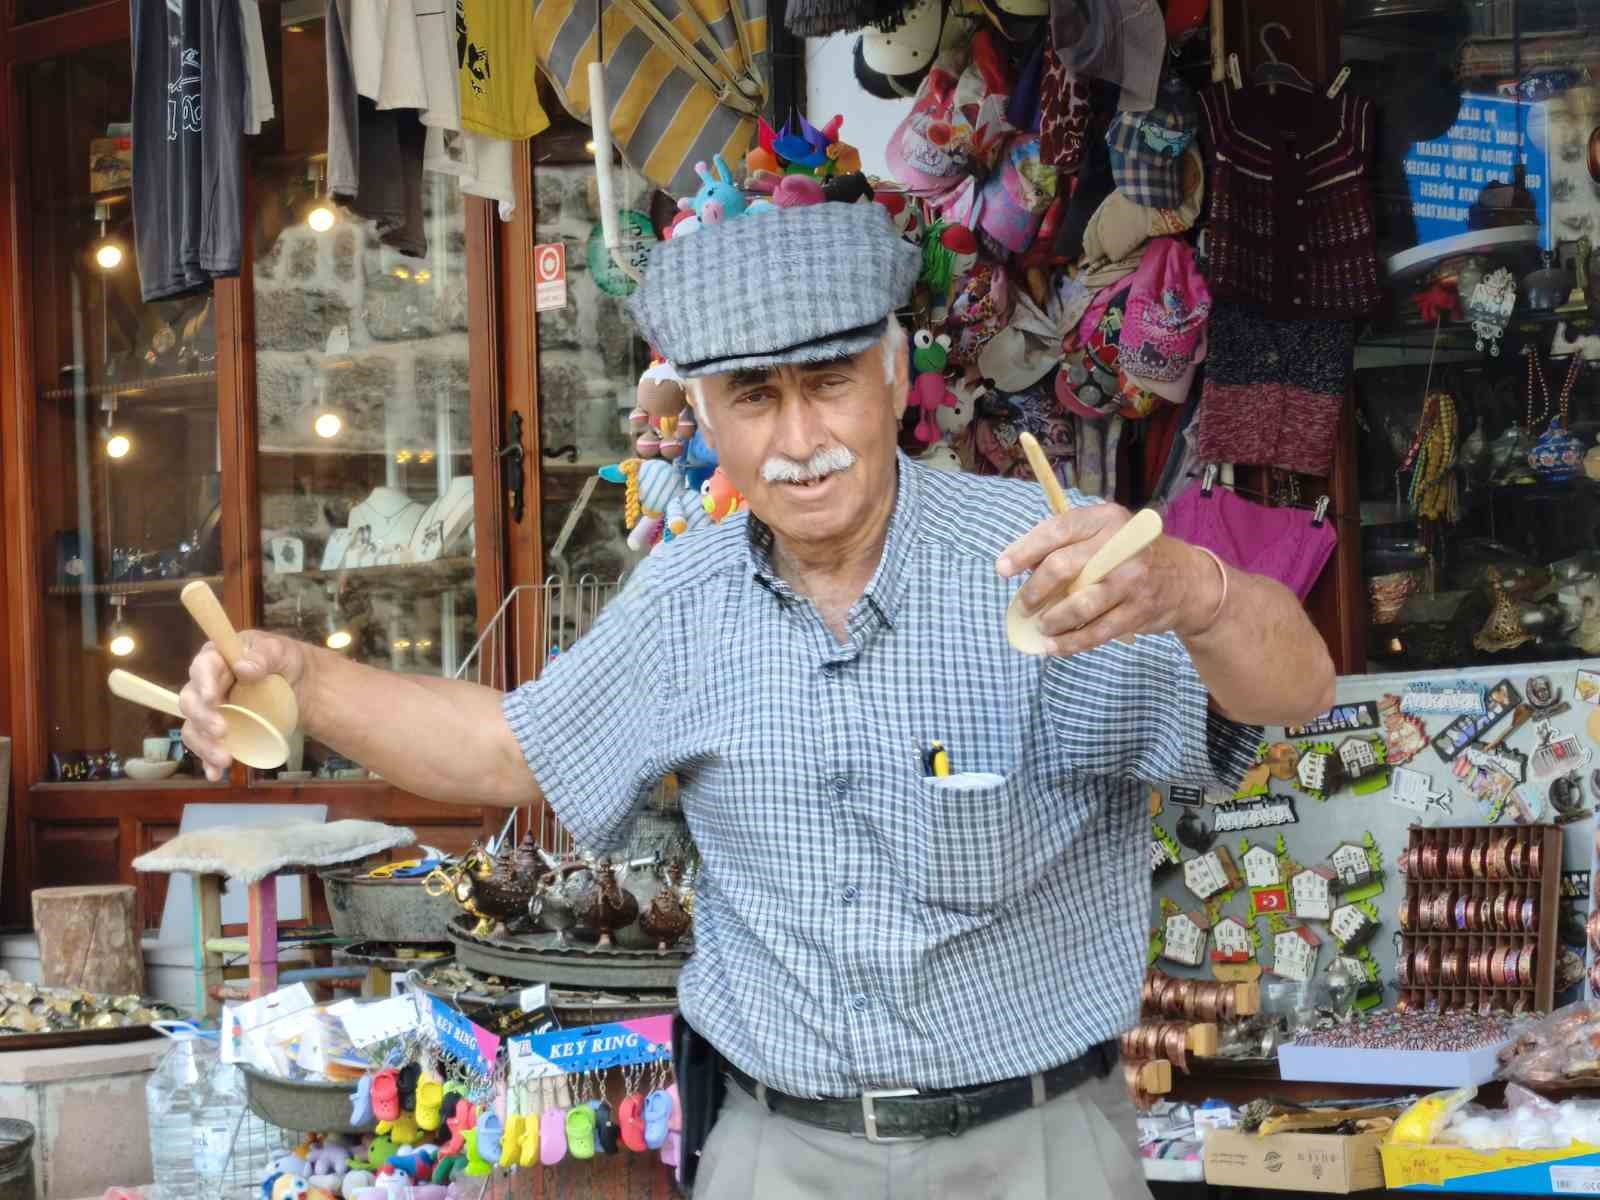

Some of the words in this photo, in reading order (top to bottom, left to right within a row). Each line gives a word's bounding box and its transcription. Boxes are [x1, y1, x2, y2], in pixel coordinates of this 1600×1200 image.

[436, 1015, 453, 1035] KEY
[453, 1025, 478, 1050] RING
[550, 1040, 587, 1059] KEY
[591, 1033, 639, 1053] RING
